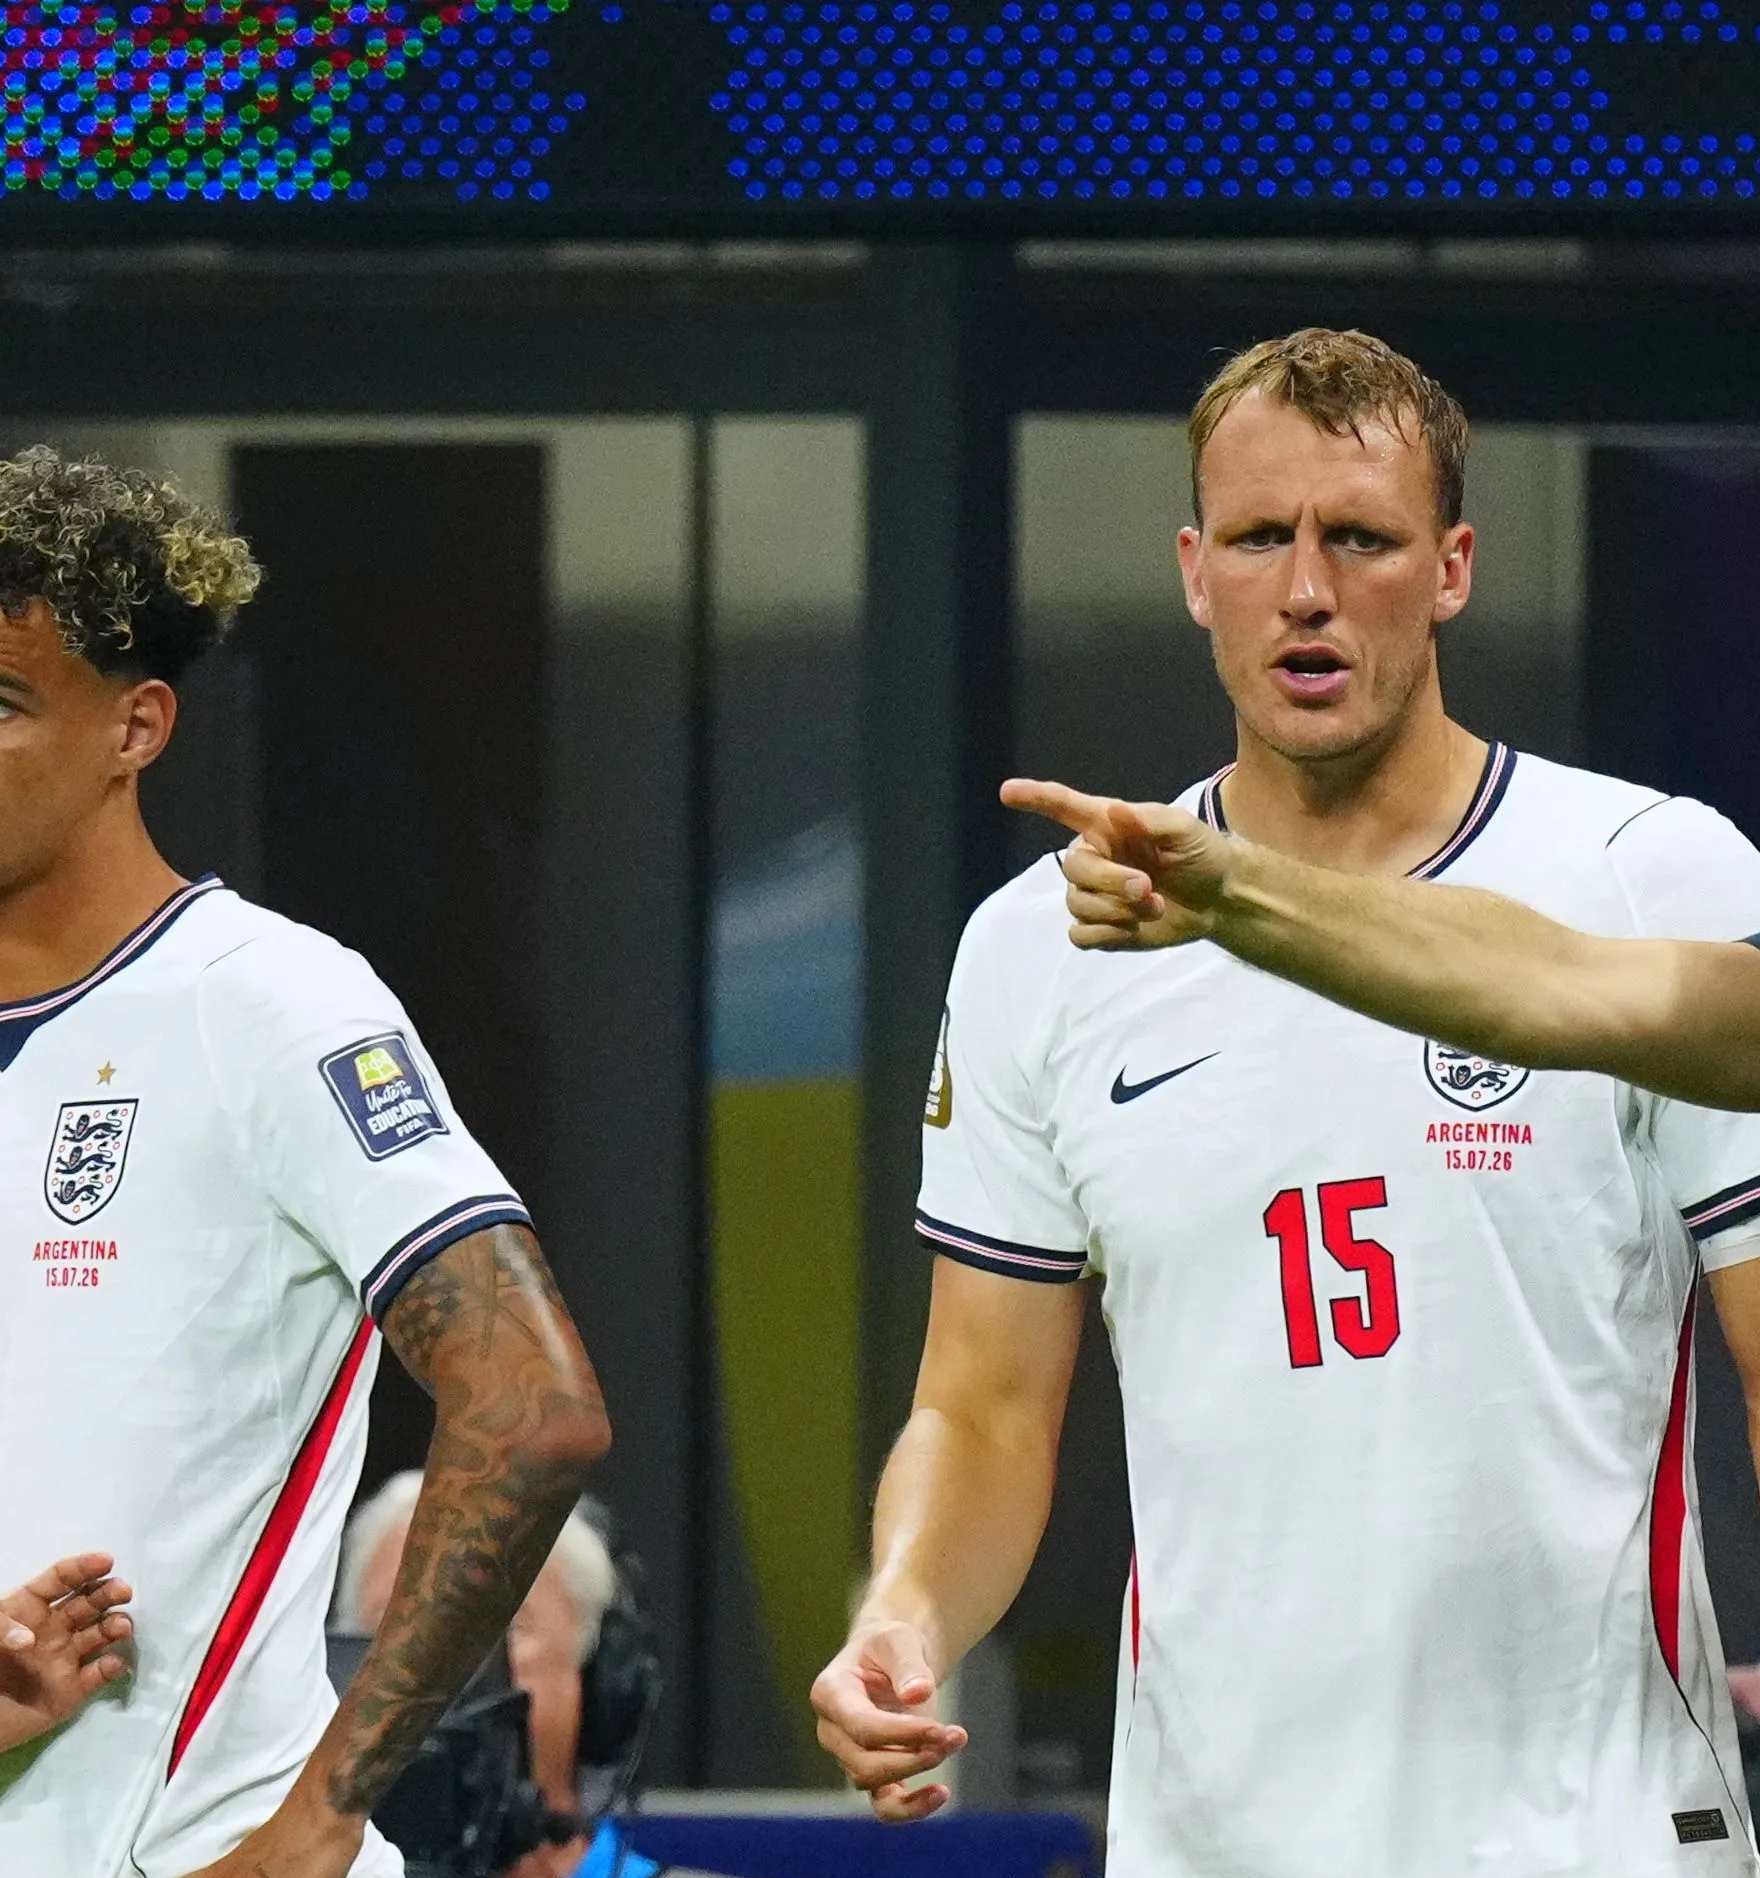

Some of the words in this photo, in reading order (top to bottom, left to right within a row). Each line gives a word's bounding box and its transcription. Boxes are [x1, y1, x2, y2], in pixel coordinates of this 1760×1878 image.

[396, 1117, 424, 1137] FIFA
[1426, 1122, 1533, 1144] ARGENTINA
[1445, 1149, 1513, 1171] 15.07.26
[33, 1240, 118, 1261] ARGENTINA
[46, 1267, 99, 1287] 15.07.26
[1263, 1175, 1402, 1369] 15
